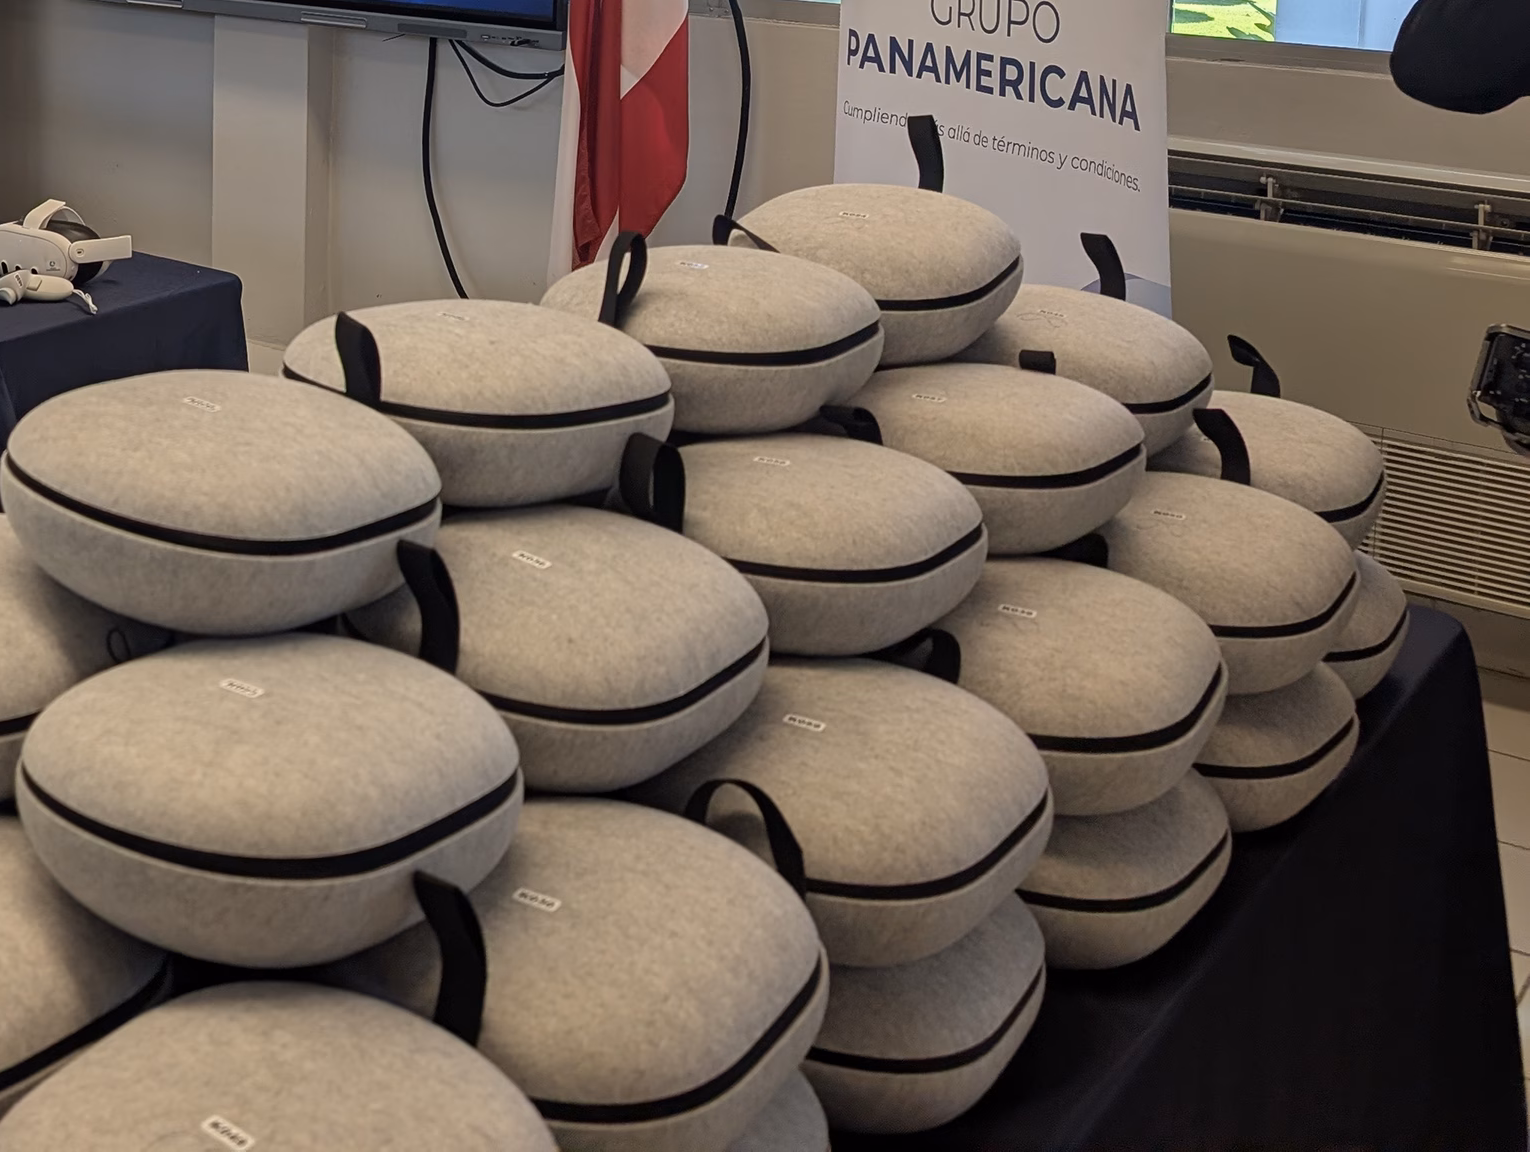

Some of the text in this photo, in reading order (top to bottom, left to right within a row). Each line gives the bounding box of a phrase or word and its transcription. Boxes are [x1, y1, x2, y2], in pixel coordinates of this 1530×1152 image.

[846, 28, 1141, 132] PANAMERICANA
[843, 100, 908, 128] Cumpliend
[947, 125, 971, 144] allá
[973, 130, 989, 149] de
[992, 135, 1055, 164] términos
[1056, 153, 1068, 170] y
[1070, 153, 1142, 193] condiciones.
